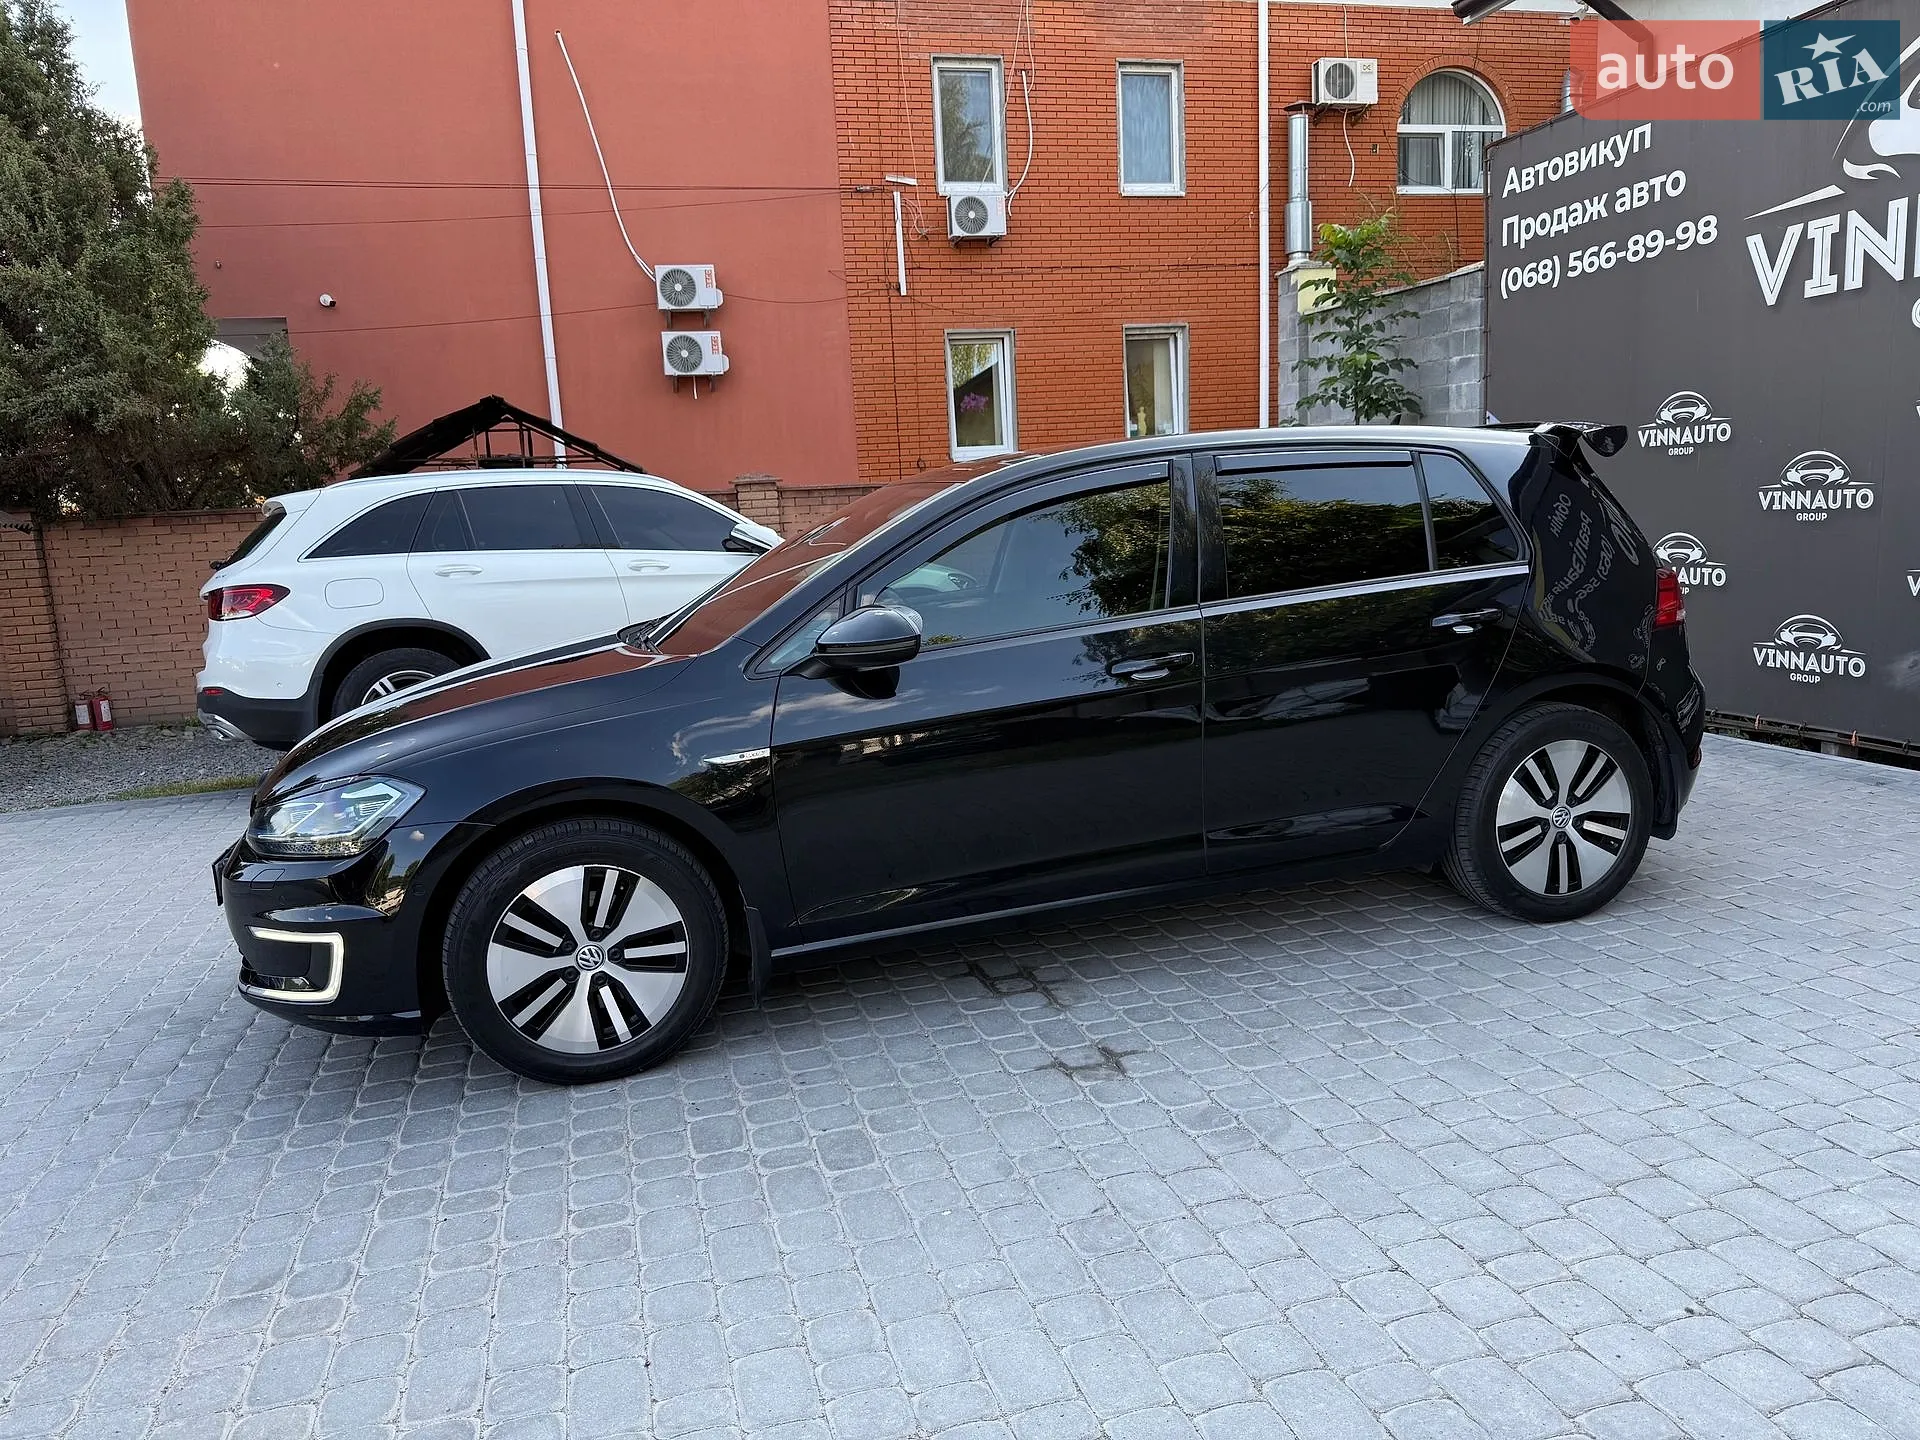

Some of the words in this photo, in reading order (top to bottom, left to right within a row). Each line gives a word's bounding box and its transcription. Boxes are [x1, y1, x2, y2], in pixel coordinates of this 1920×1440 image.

[1502, 123, 1652, 198] Автовикуп
[1502, 193, 1609, 249] Продаж
[1614, 170, 1687, 213] авто
[1501, 255, 1561, 300] (068)
[1567, 215, 1718, 278] 566-89-98
[1638, 423, 1732, 447] VINNAUTO
[1668, 447, 1694, 456] GROUP
[1759, 488, 1874, 510] VINNAUTO
[1796, 512, 1828, 521] GROUP
[1753, 647, 1866, 678] VINNAUTO
[1789, 673, 1821, 684] GROUP
